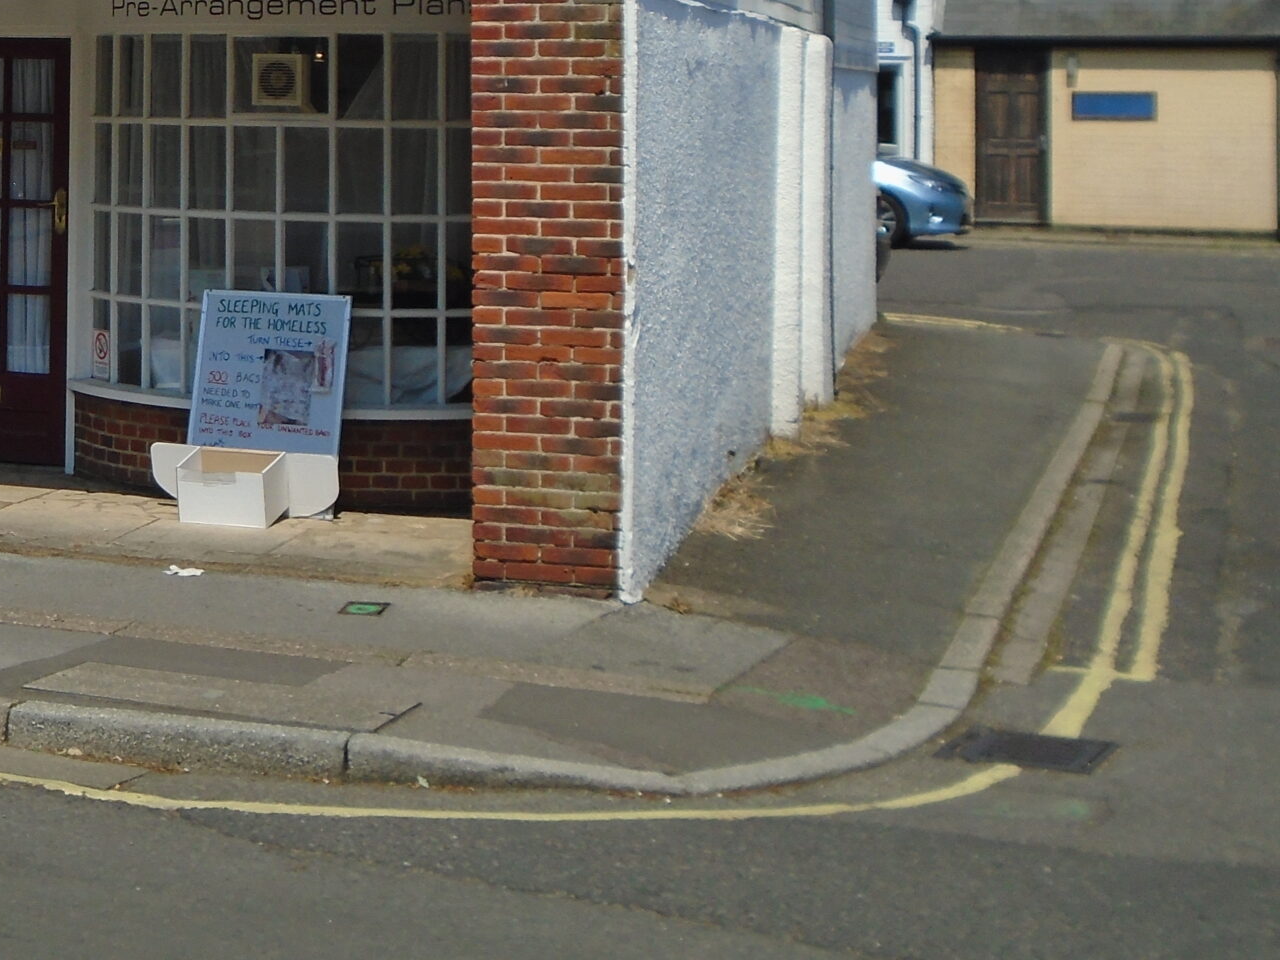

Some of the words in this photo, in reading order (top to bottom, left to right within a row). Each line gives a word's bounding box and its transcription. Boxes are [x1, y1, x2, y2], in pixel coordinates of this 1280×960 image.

[217, 298, 279, 317] SLEEPING
[287, 302, 321, 317] MATS
[216, 316, 236, 329] FOR
[242, 316, 262, 330] THE
[267, 319, 327, 335] HOMELESS
[248, 335, 271, 345] TURN
[274, 336, 304, 348] THESE
[208, 370, 229, 383] 500
[203, 387, 238, 397] NEEDED
